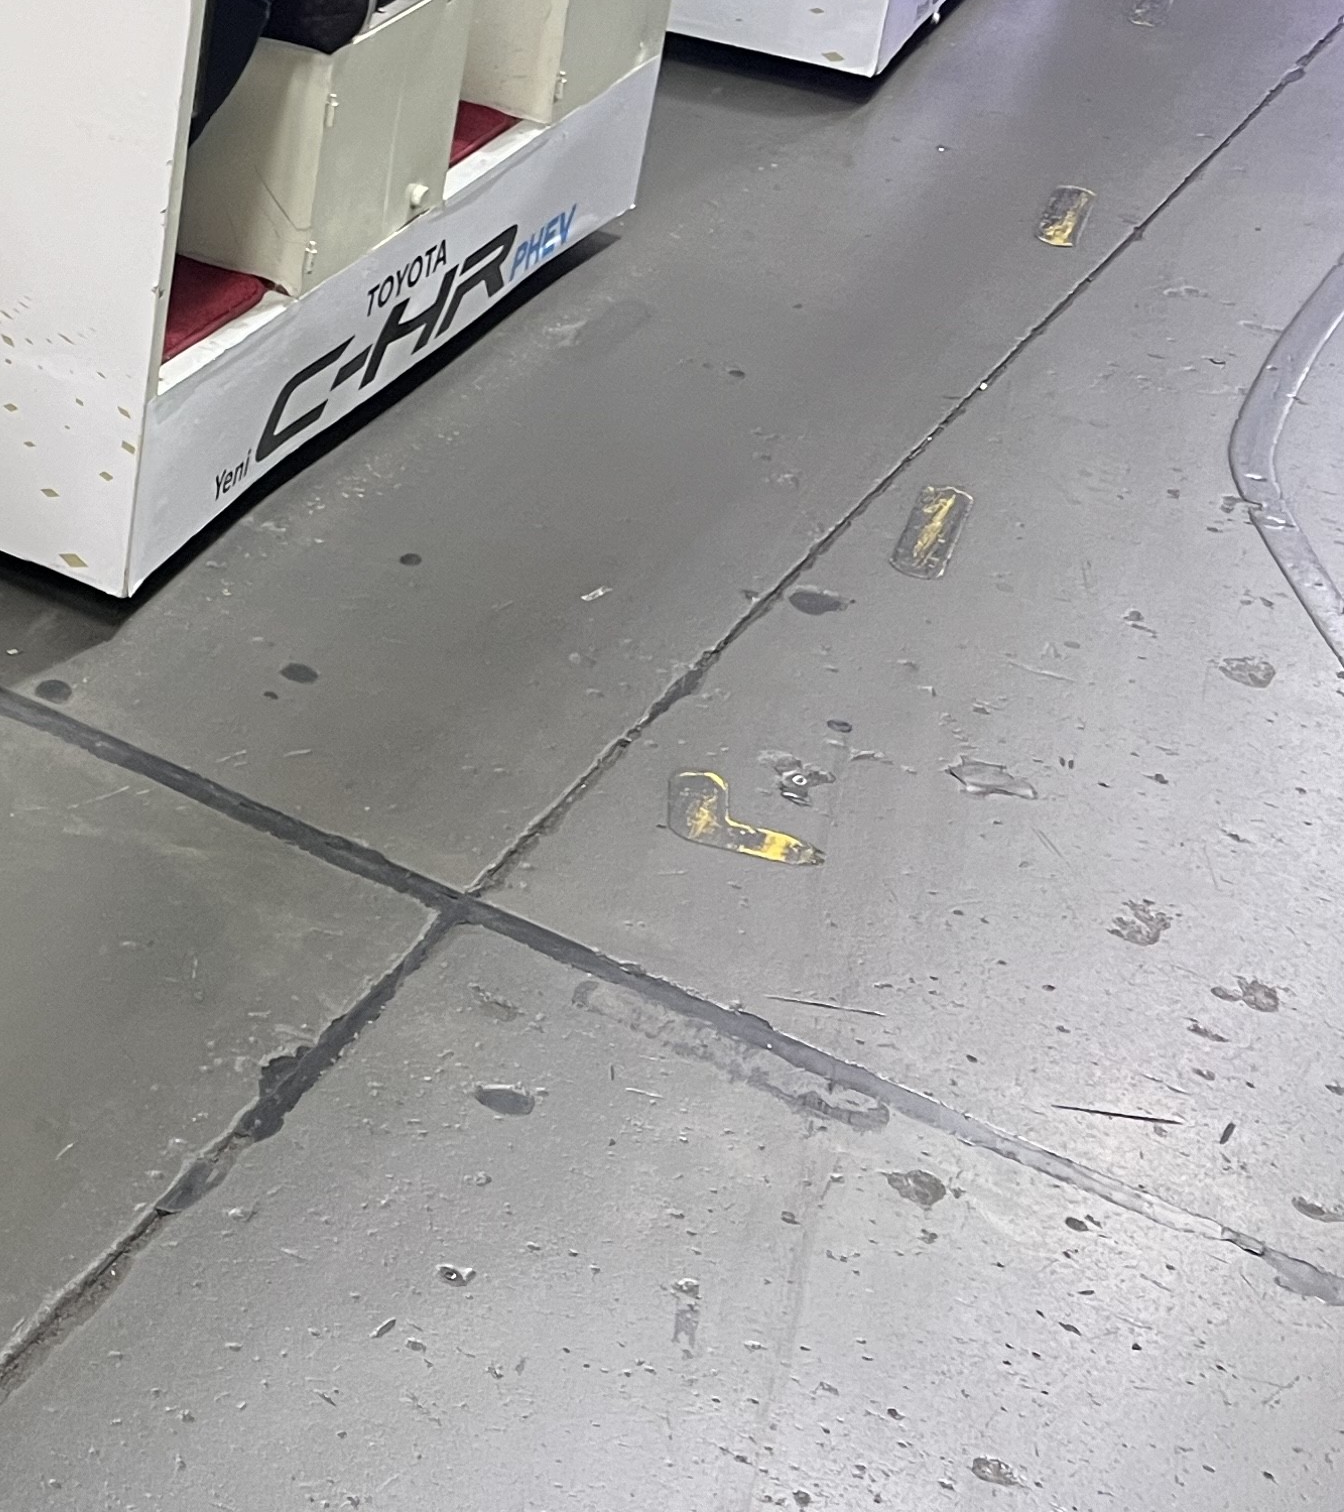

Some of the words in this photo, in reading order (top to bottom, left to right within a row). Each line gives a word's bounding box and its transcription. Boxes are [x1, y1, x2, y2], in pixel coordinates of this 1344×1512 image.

[214, 448, 253, 501] Yeni
[255, 224, 518, 463] C-HR
[508, 203, 577, 282] PHEV
[367, 239, 447, 317] TOYOTA
